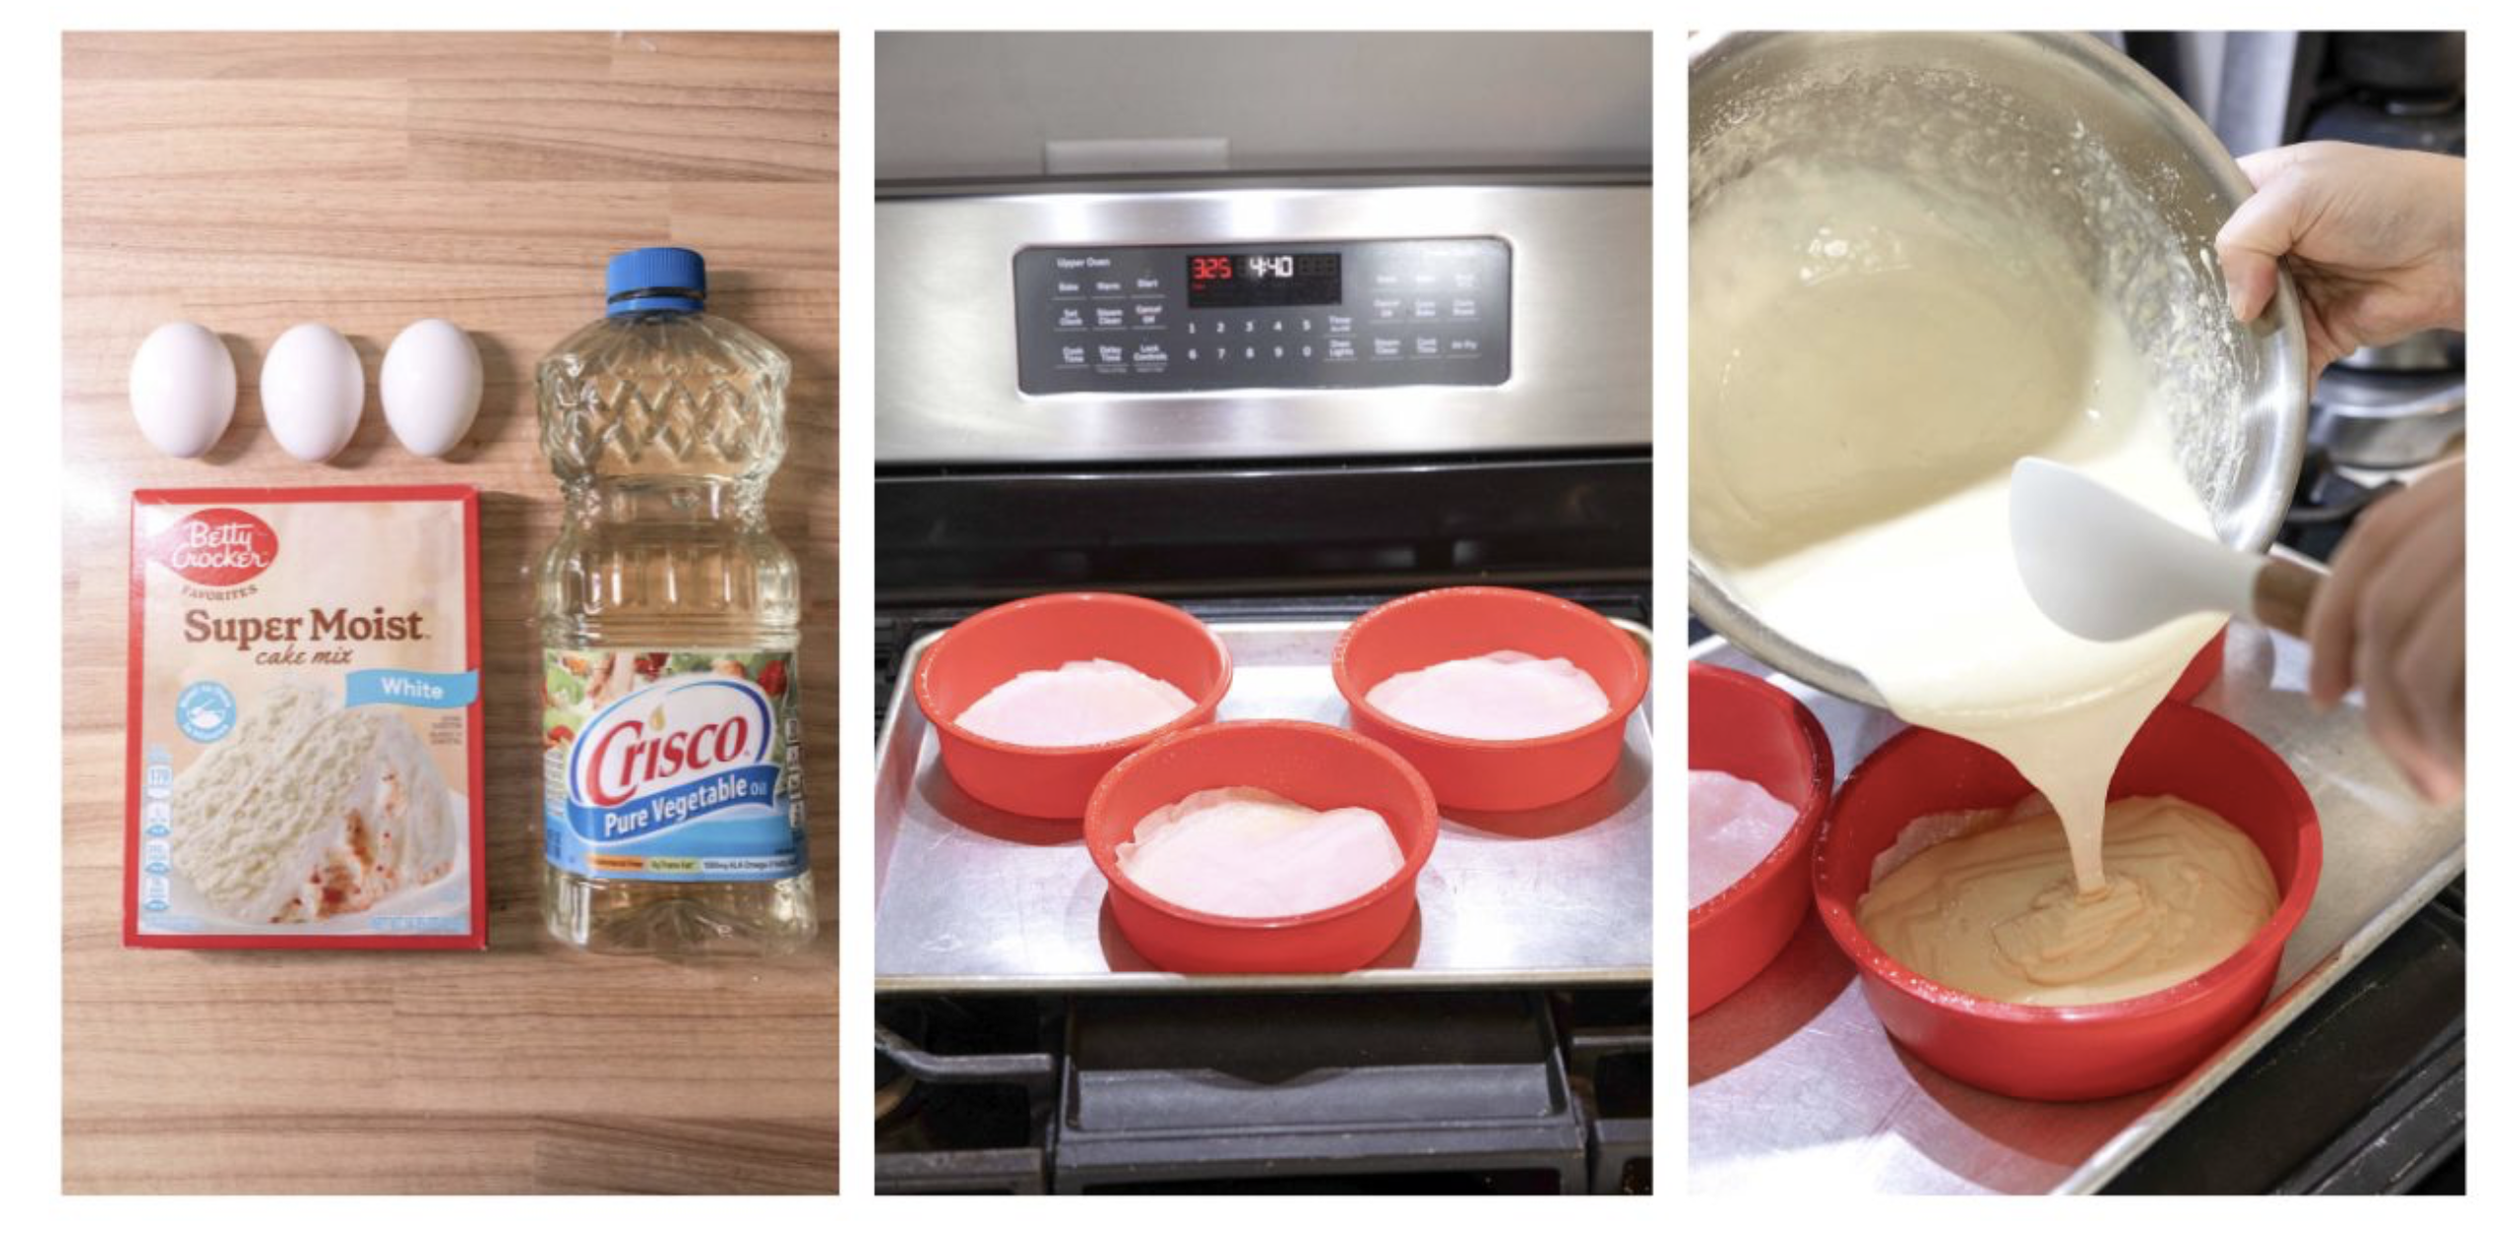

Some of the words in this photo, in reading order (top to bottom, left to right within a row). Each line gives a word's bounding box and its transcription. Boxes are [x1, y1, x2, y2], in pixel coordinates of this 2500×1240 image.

[1057, 257, 1084, 269] Upper
[1086, 256, 1110, 268] Oven
[1192, 256, 1233, 280] 325
[1250, 255, 1294, 278] 4:40
[1137, 279, 1158, 289] Start
[1063, 309, 1078, 318] Set
[1135, 304, 1162, 314] Cancel
[1059, 317, 1083, 326] Clock
[1133, 352, 1168, 361] Controls
[1140, 344, 1159, 353] Lock
[184, 521, 254, 552] Betty
[172, 544, 267, 570] Crocker
[181, 584, 259, 601] FAVORITES
[184, 608, 303, 651] Super
[310, 606, 423, 641] Moist
[255, 643, 306, 666] cake
[311, 645, 354, 665] mix
[380, 675, 445, 701] White
[585, 715, 748, 808] Crisco
[604, 809, 648, 838] Pure
[651, 773, 747, 822] Vegetable
